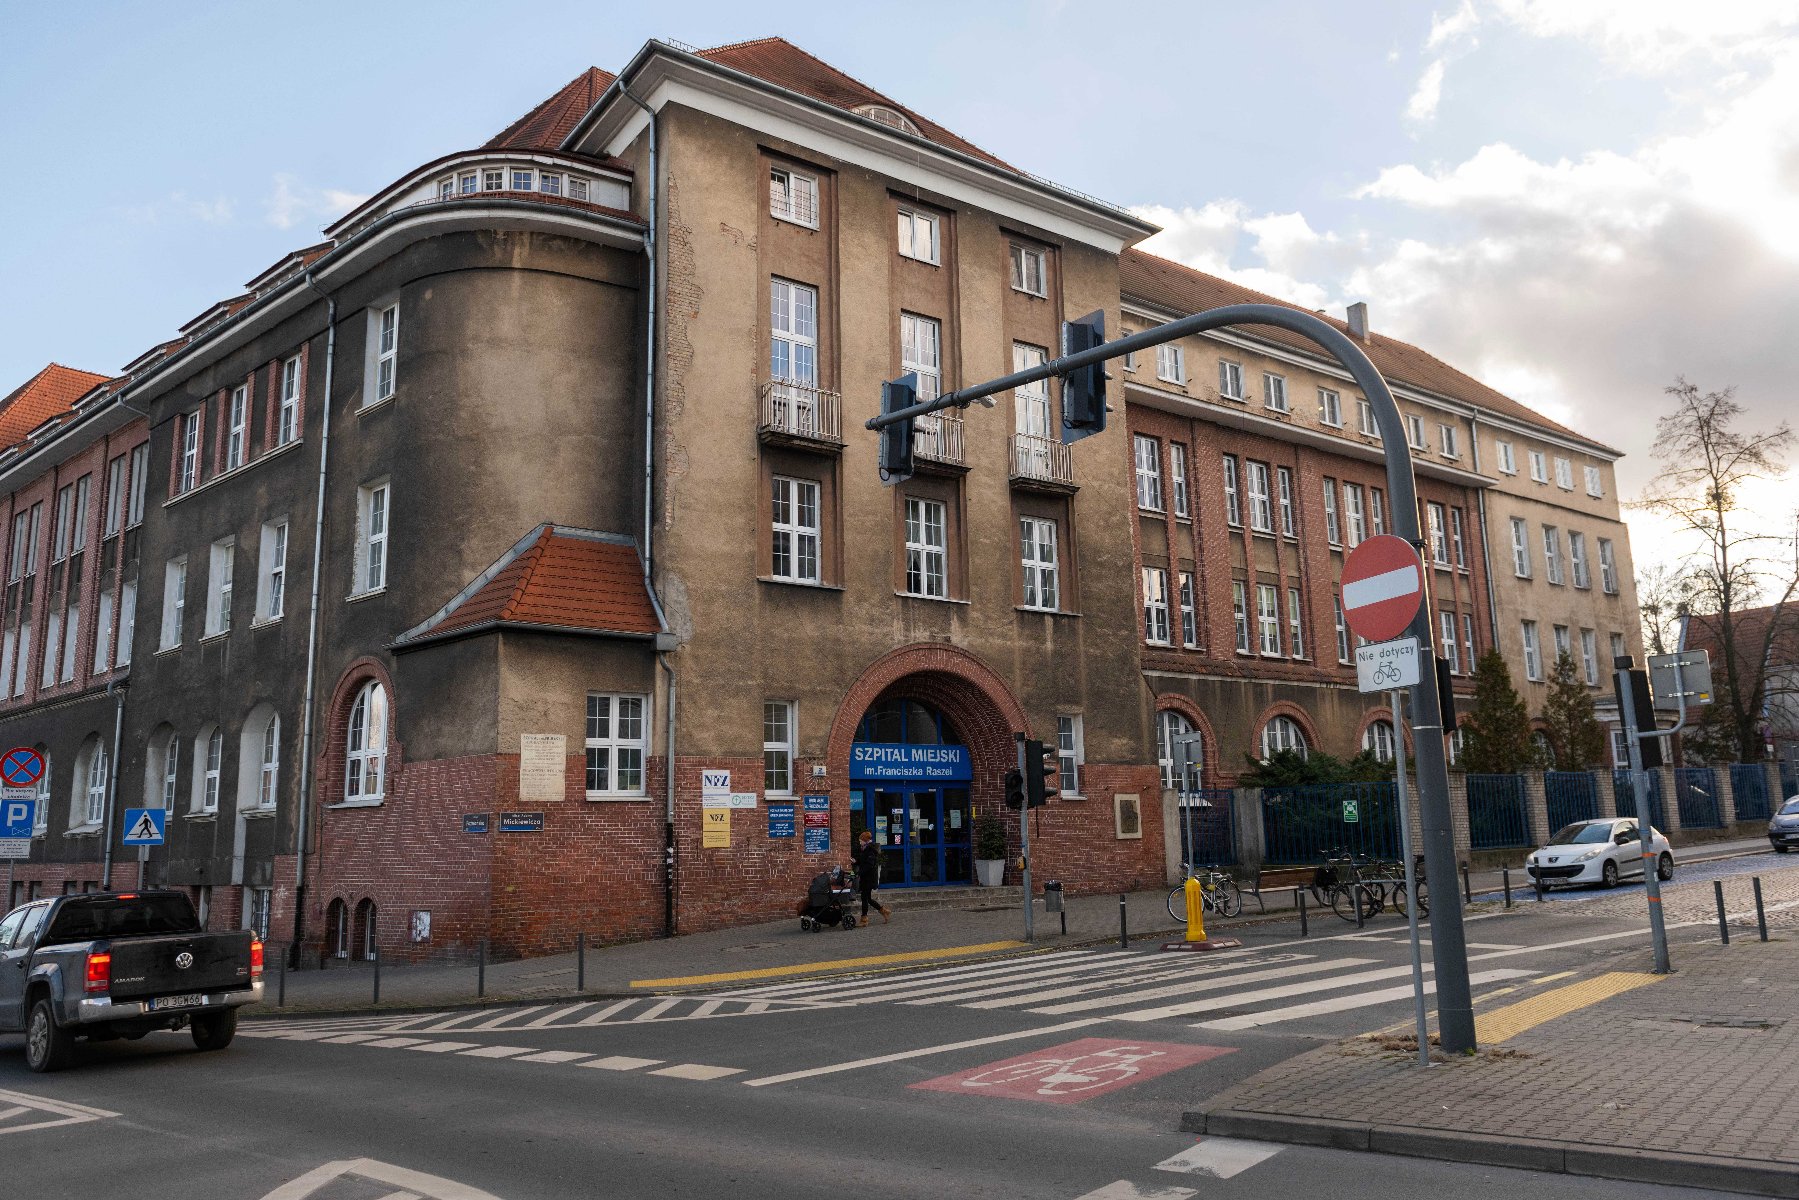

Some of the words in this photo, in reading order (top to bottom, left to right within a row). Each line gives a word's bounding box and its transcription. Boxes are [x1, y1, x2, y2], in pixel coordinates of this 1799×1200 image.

[1358, 651, 1374, 662] Nie
[1379, 645, 1415, 658] dotyczy
[854, 747, 909, 762] SZPITAL
[911, 749, 960, 763] MIEJSKI
[703, 774, 729, 787] NFZ
[6, 803, 28, 827] P
[709, 813, 725, 822] NFZ
[114, 976, 145, 984] AMAROK
